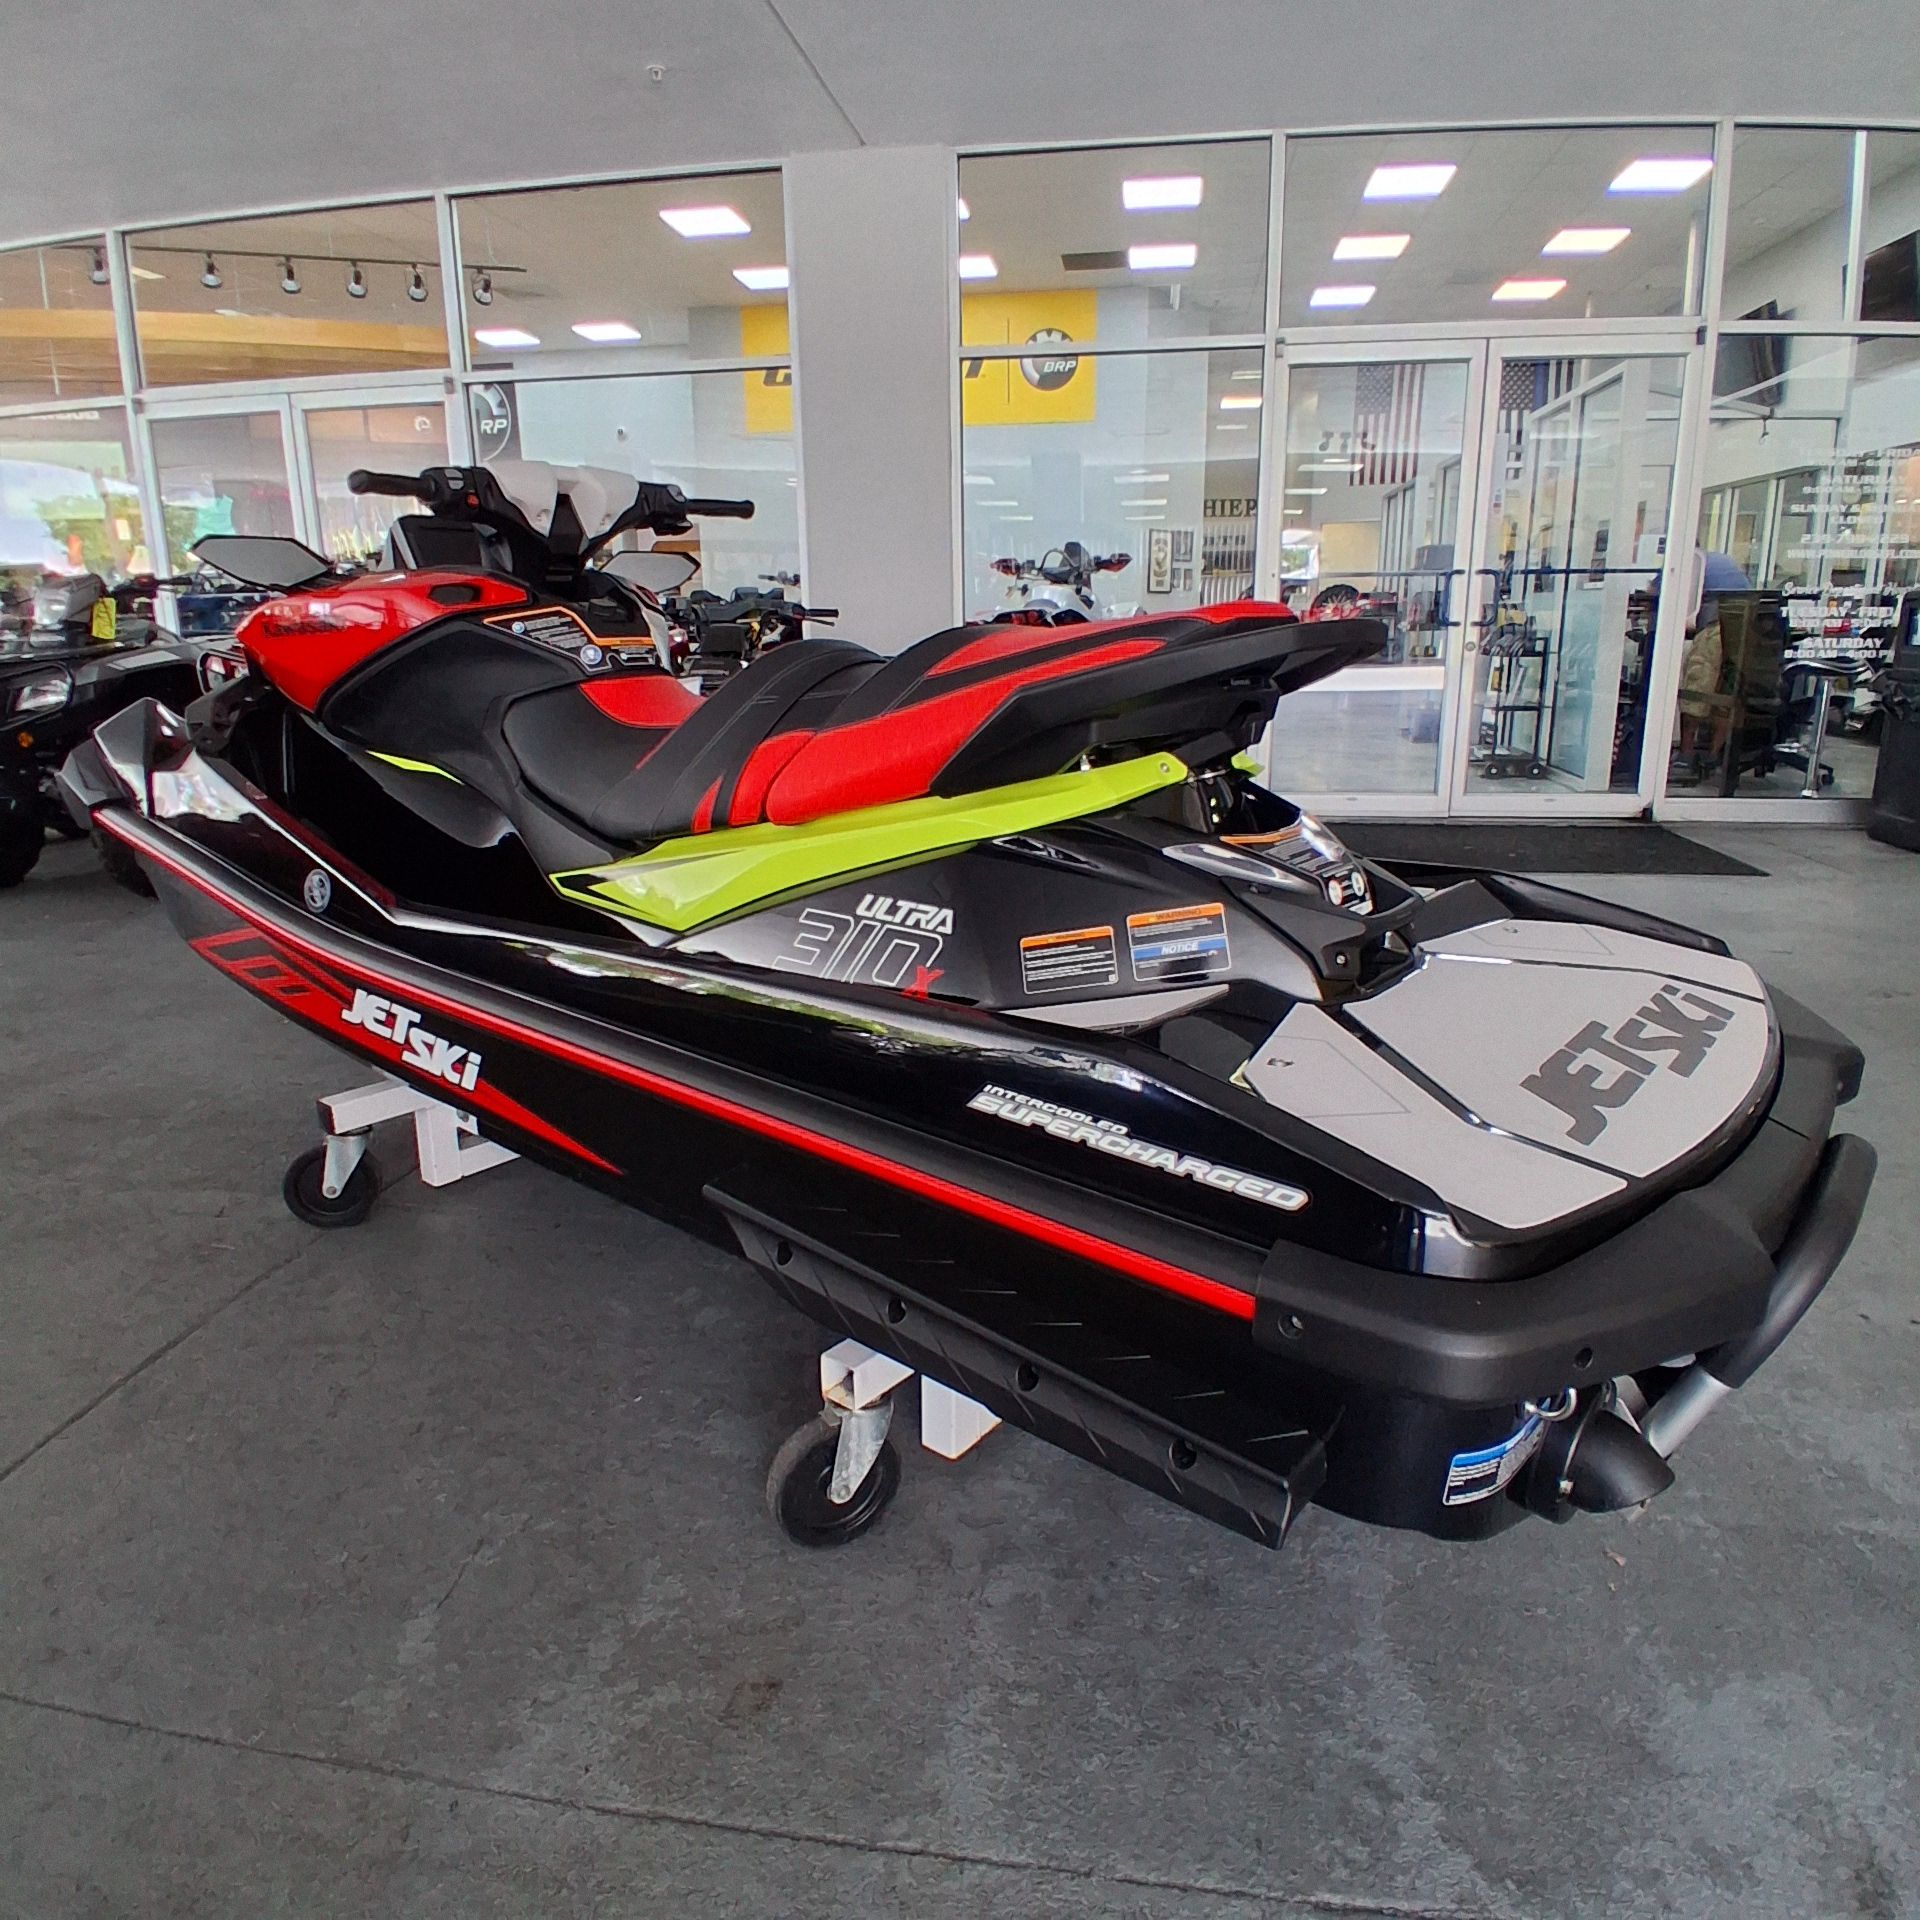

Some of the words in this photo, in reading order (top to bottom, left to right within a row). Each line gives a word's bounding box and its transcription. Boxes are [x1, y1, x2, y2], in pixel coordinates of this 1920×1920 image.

[1043, 360, 1077, 372] BRP
[1801, 638, 1884, 648] SATURDAY
[855, 893, 954, 934] ULTRA
[1161, 941, 1199, 955] NOTICE
[341, 989, 421, 1045] JET
[1519, 1020, 1657, 1146] JET
[982, 1084, 1129, 1136] INTERCOOLED
[966, 1092, 1309, 1211] SUPERCHARGED
